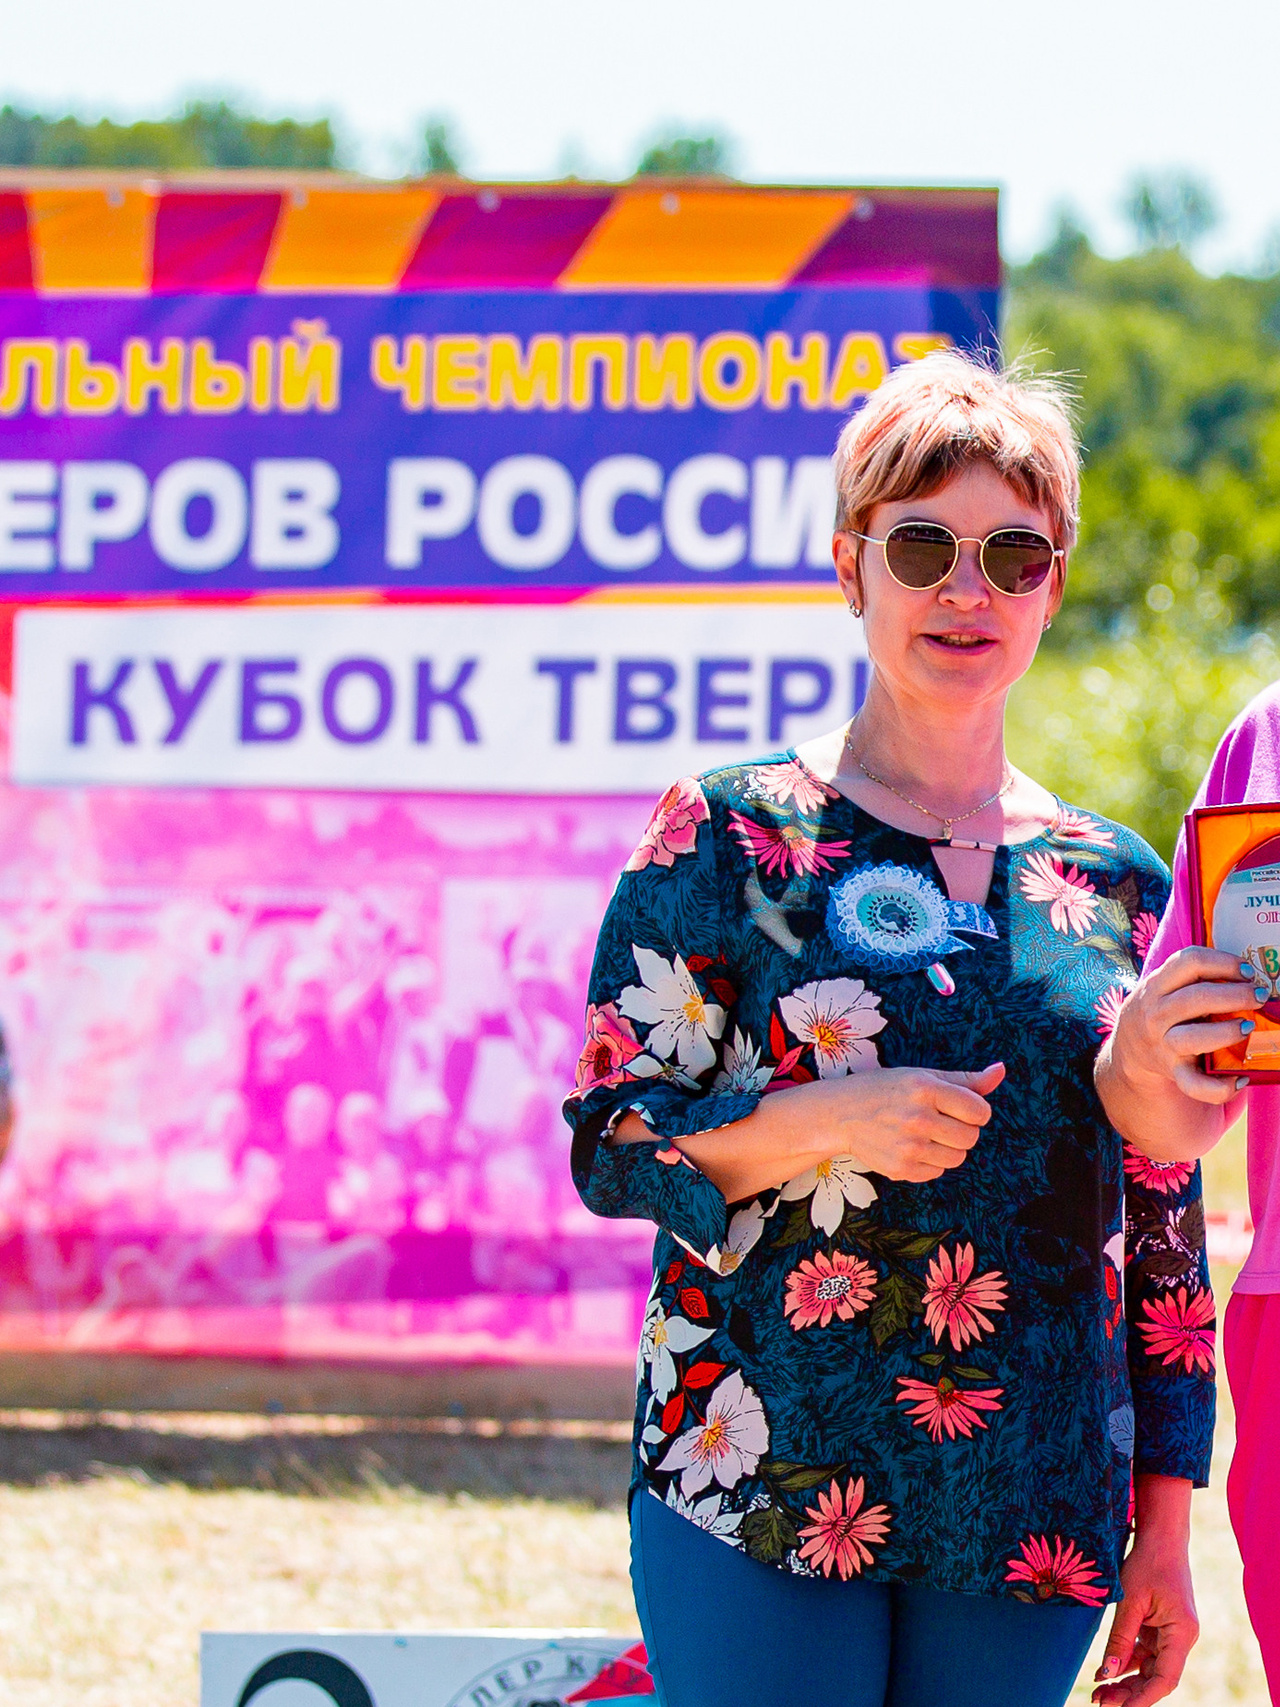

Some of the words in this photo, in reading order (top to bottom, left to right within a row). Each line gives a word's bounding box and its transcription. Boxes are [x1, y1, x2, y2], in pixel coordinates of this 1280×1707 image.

[0, 320, 341, 413] ЛЬНЫЙ
[0, 458, 340, 574] ЕРОВ
[68, 655, 480, 747] КУБОК
[1265, 948, 1280, 974] 3
